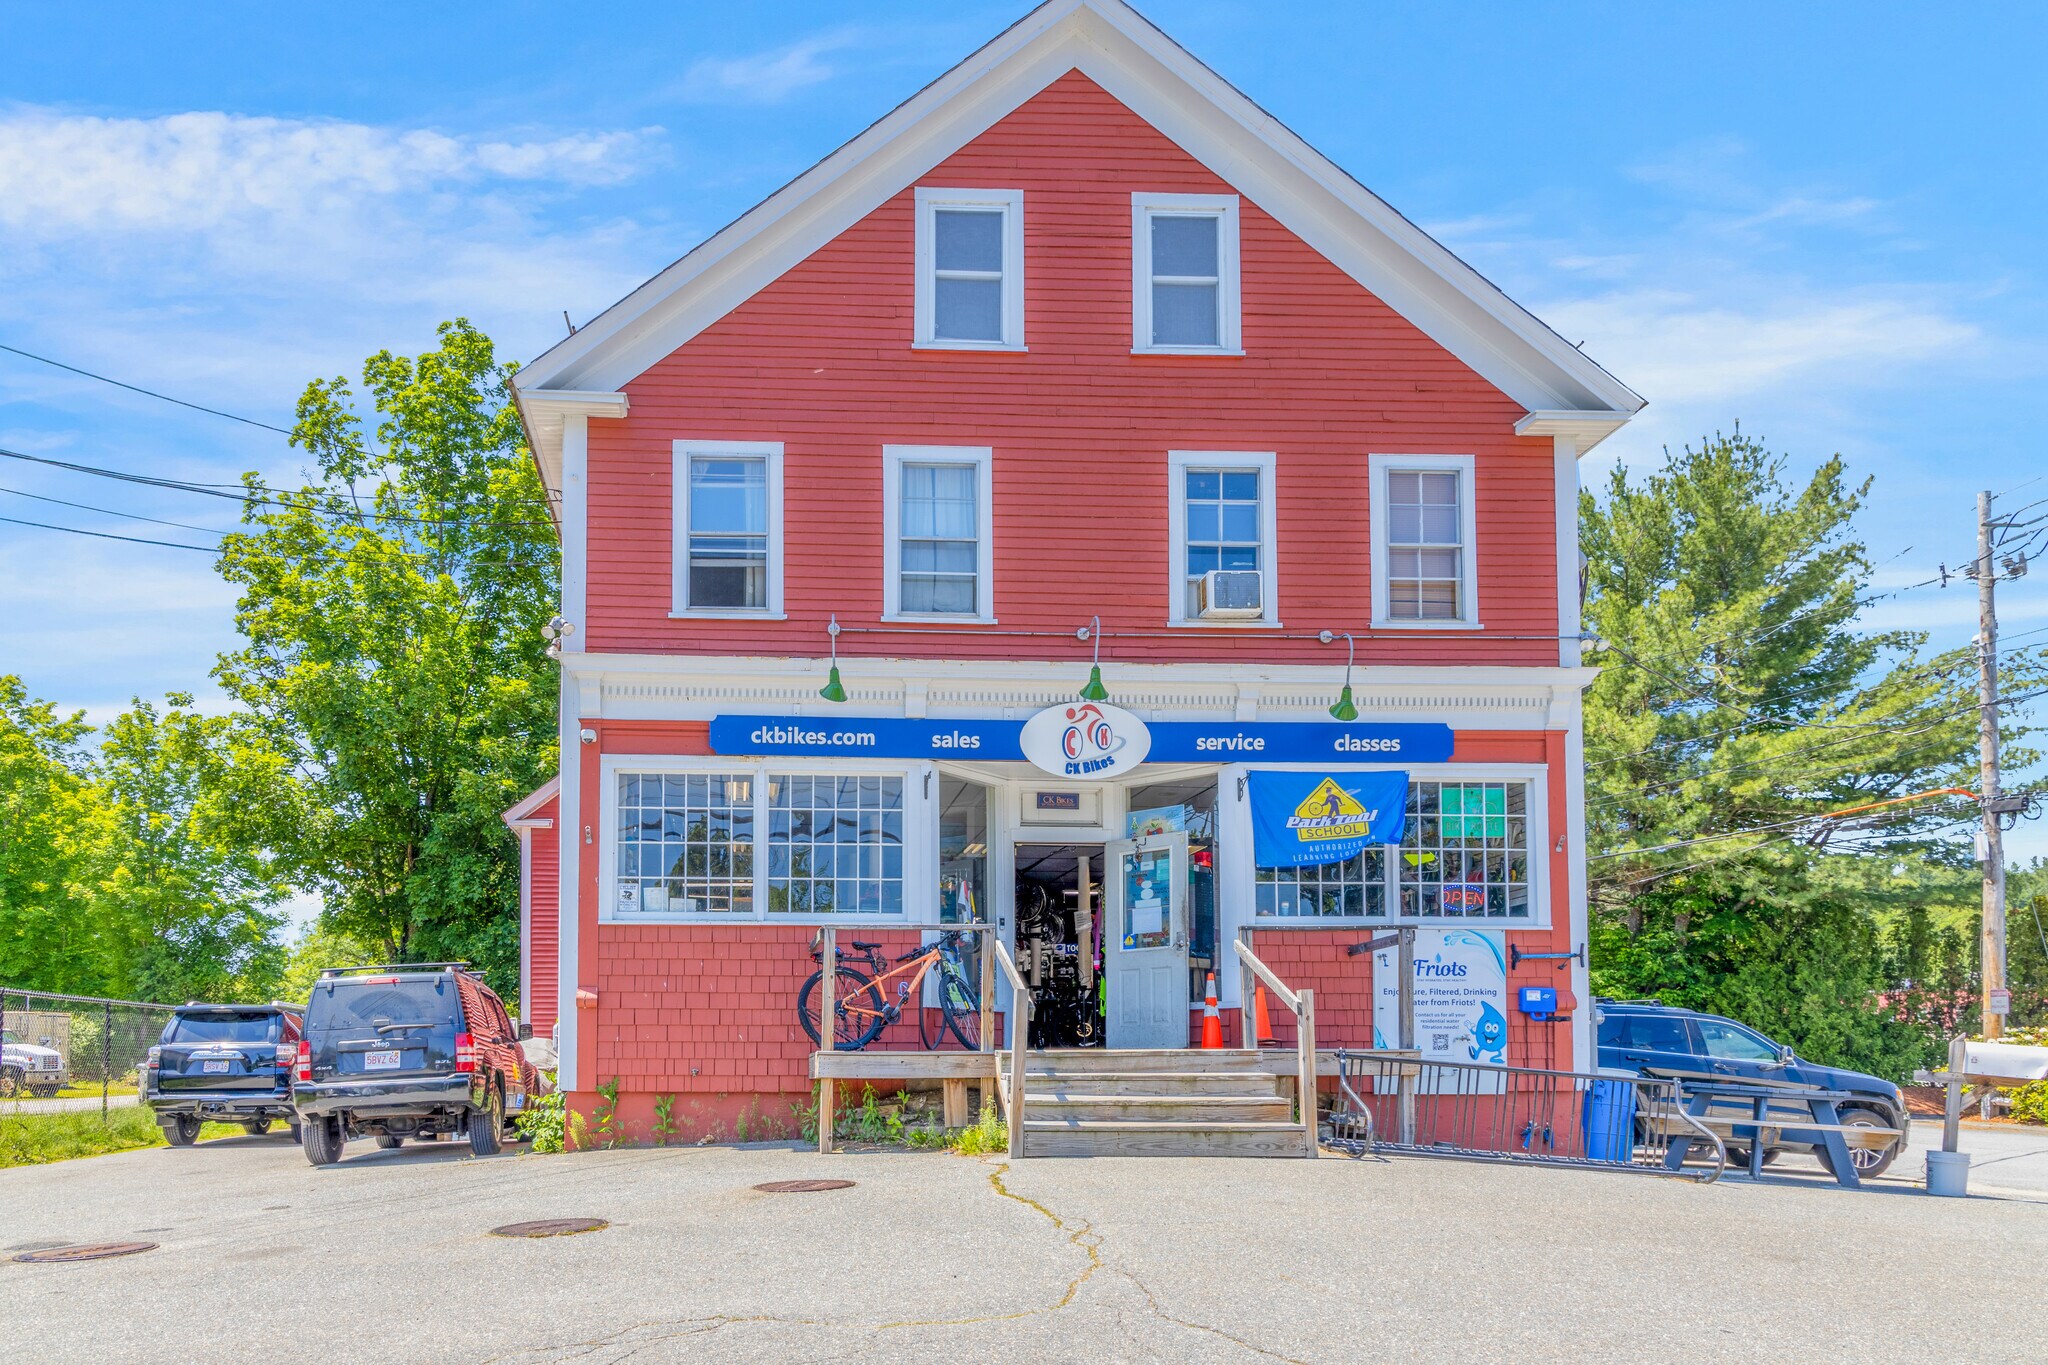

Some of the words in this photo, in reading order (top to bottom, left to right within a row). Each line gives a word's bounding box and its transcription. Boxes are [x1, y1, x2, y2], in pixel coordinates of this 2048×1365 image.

[750, 726, 876, 747] ckbikes.com
[931, 730, 981, 749] sales
[1196, 733, 1265, 751] service
[1333, 733, 1401, 752] classes
[1065, 762, 1081, 775] CK
[1082, 755, 1115, 774] Bikes
[1286, 815, 1334, 829] Park
[1331, 809, 1379, 825] Tool
[1446, 821, 1462, 831] BIK
[1306, 824, 1361, 838] SCHOOL
[1309, 840, 1363, 853] AUTHORIZED
[1292, 852, 1335, 863] LEARNING
[1443, 891, 1485, 905] OPEN
[1413, 959, 1468, 977] Friots
[1430, 988, 1462, 996] Filtered,
[1463, 988, 1497, 998] Drinking
[1431, 998, 1450, 1006] from
[1451, 998, 1476, 1006] Friots!
[371, 1040, 390, 1049] Jeep
[388, 1054, 399, 1064] 62
